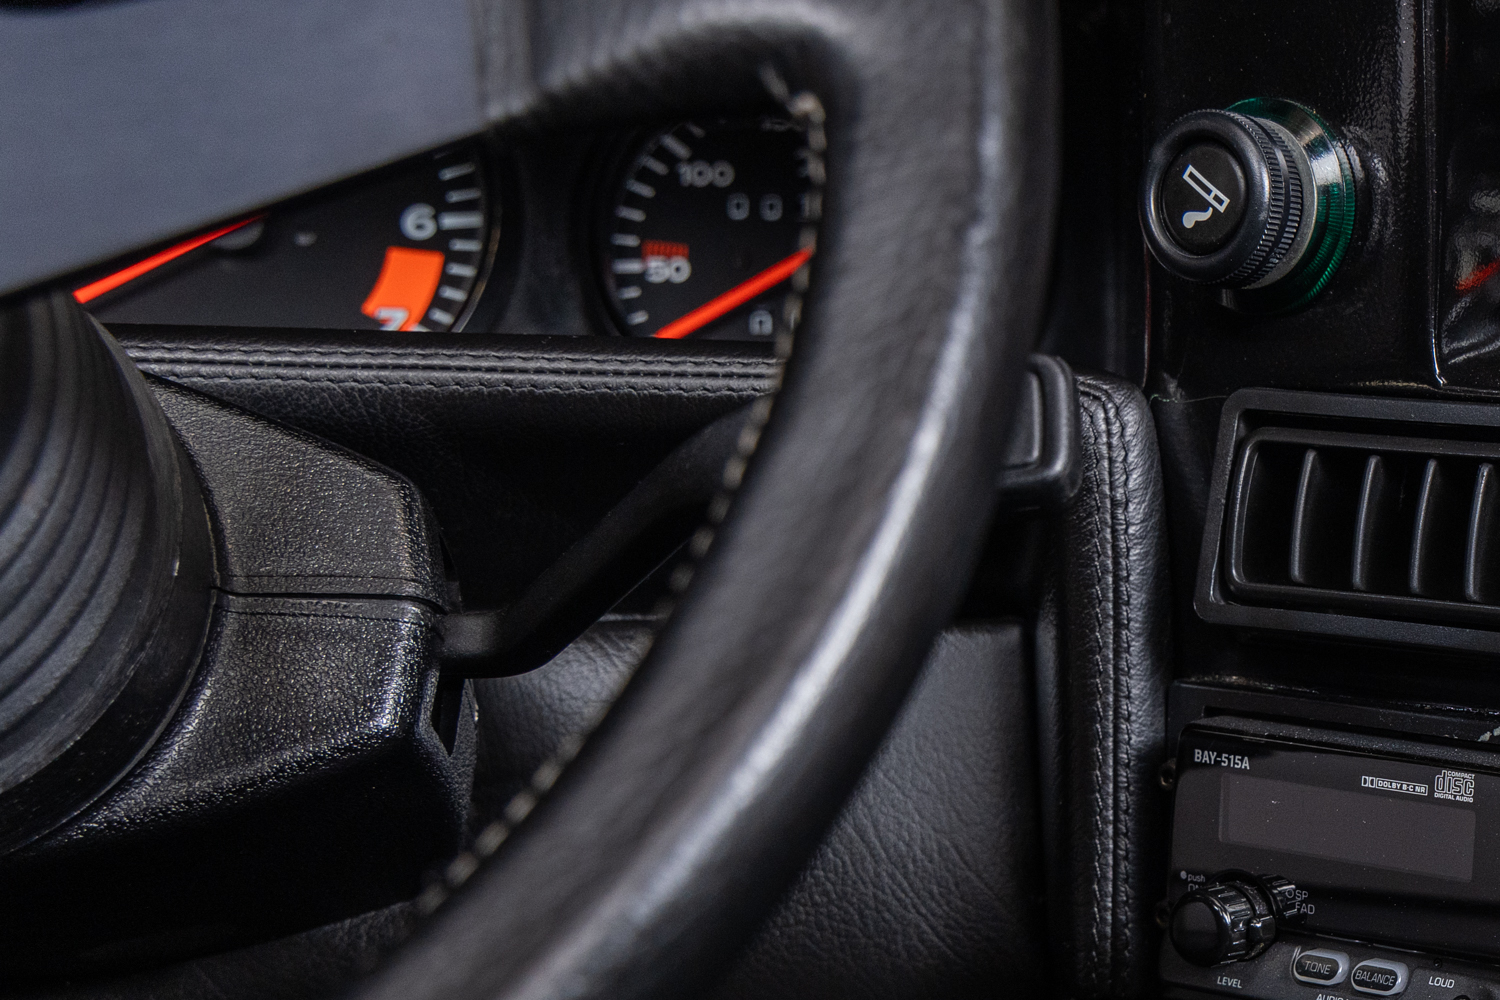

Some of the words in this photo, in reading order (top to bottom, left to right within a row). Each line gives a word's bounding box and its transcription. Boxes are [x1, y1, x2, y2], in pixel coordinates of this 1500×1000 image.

[675, 160, 735, 188] 100
[400, 203, 437, 241] 6
[373, 306, 409, 331] 7
[1194, 749, 1250, 770] BAY-515A
[1447, 771, 1475, 780] COMPACT
[1378, 780, 1401, 789] DOLBY
[1434, 792, 1455, 801] DIGITAL
[1187, 874, 1206, 882] push
[1304, 960, 1332, 975] TONE
[1216, 976, 1242, 989] LEVEL
[1355, 970, 1396, 986] BALANCE
[1428, 976, 1455, 988] LOUD
